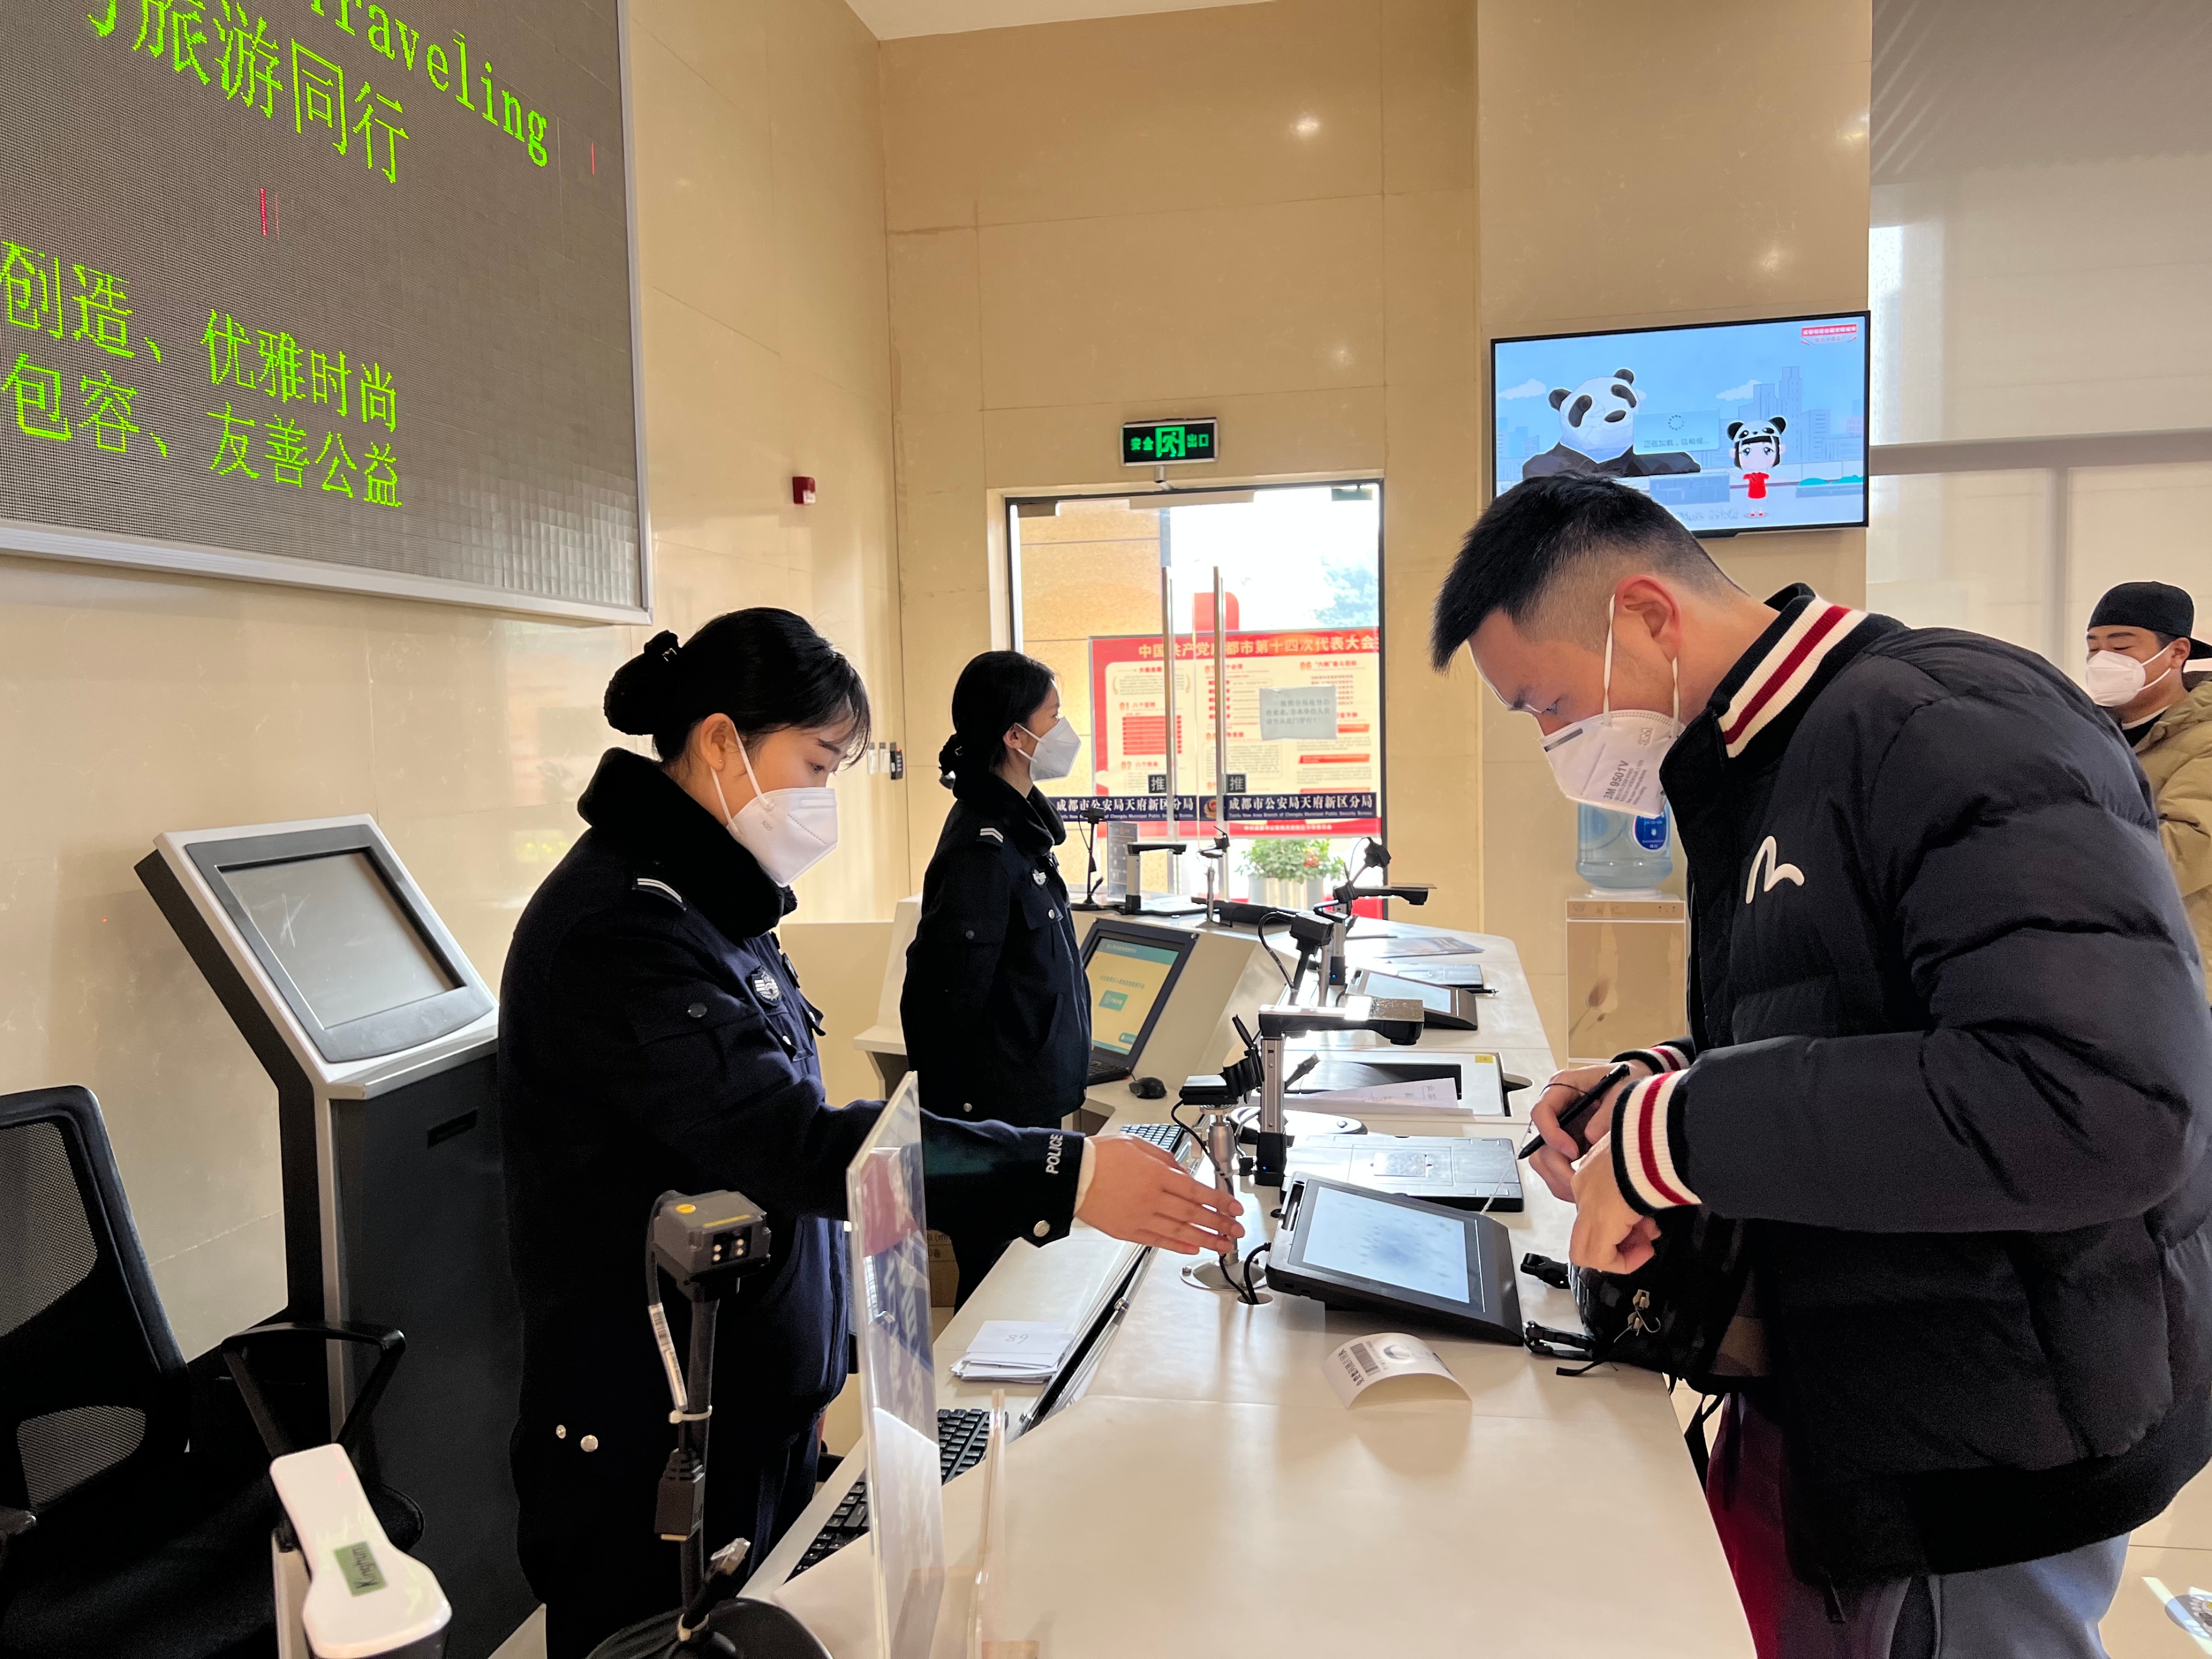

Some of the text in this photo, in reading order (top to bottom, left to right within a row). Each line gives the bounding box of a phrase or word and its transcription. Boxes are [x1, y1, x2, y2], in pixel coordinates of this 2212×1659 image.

[311, 0, 548, 167] raveling
[1130, 434, 1209, 451] 安全 出口
[1151, 777, 1165, 790] 推
[1229, 776, 1244, 791] 推
[1603, 788, 1617, 799] 3M
[1610, 760, 1629, 787] 9501V
[1229, 795, 1373, 811] 成都市公安局天府新区分局
[1045, 1134, 1064, 1174] POLICE
